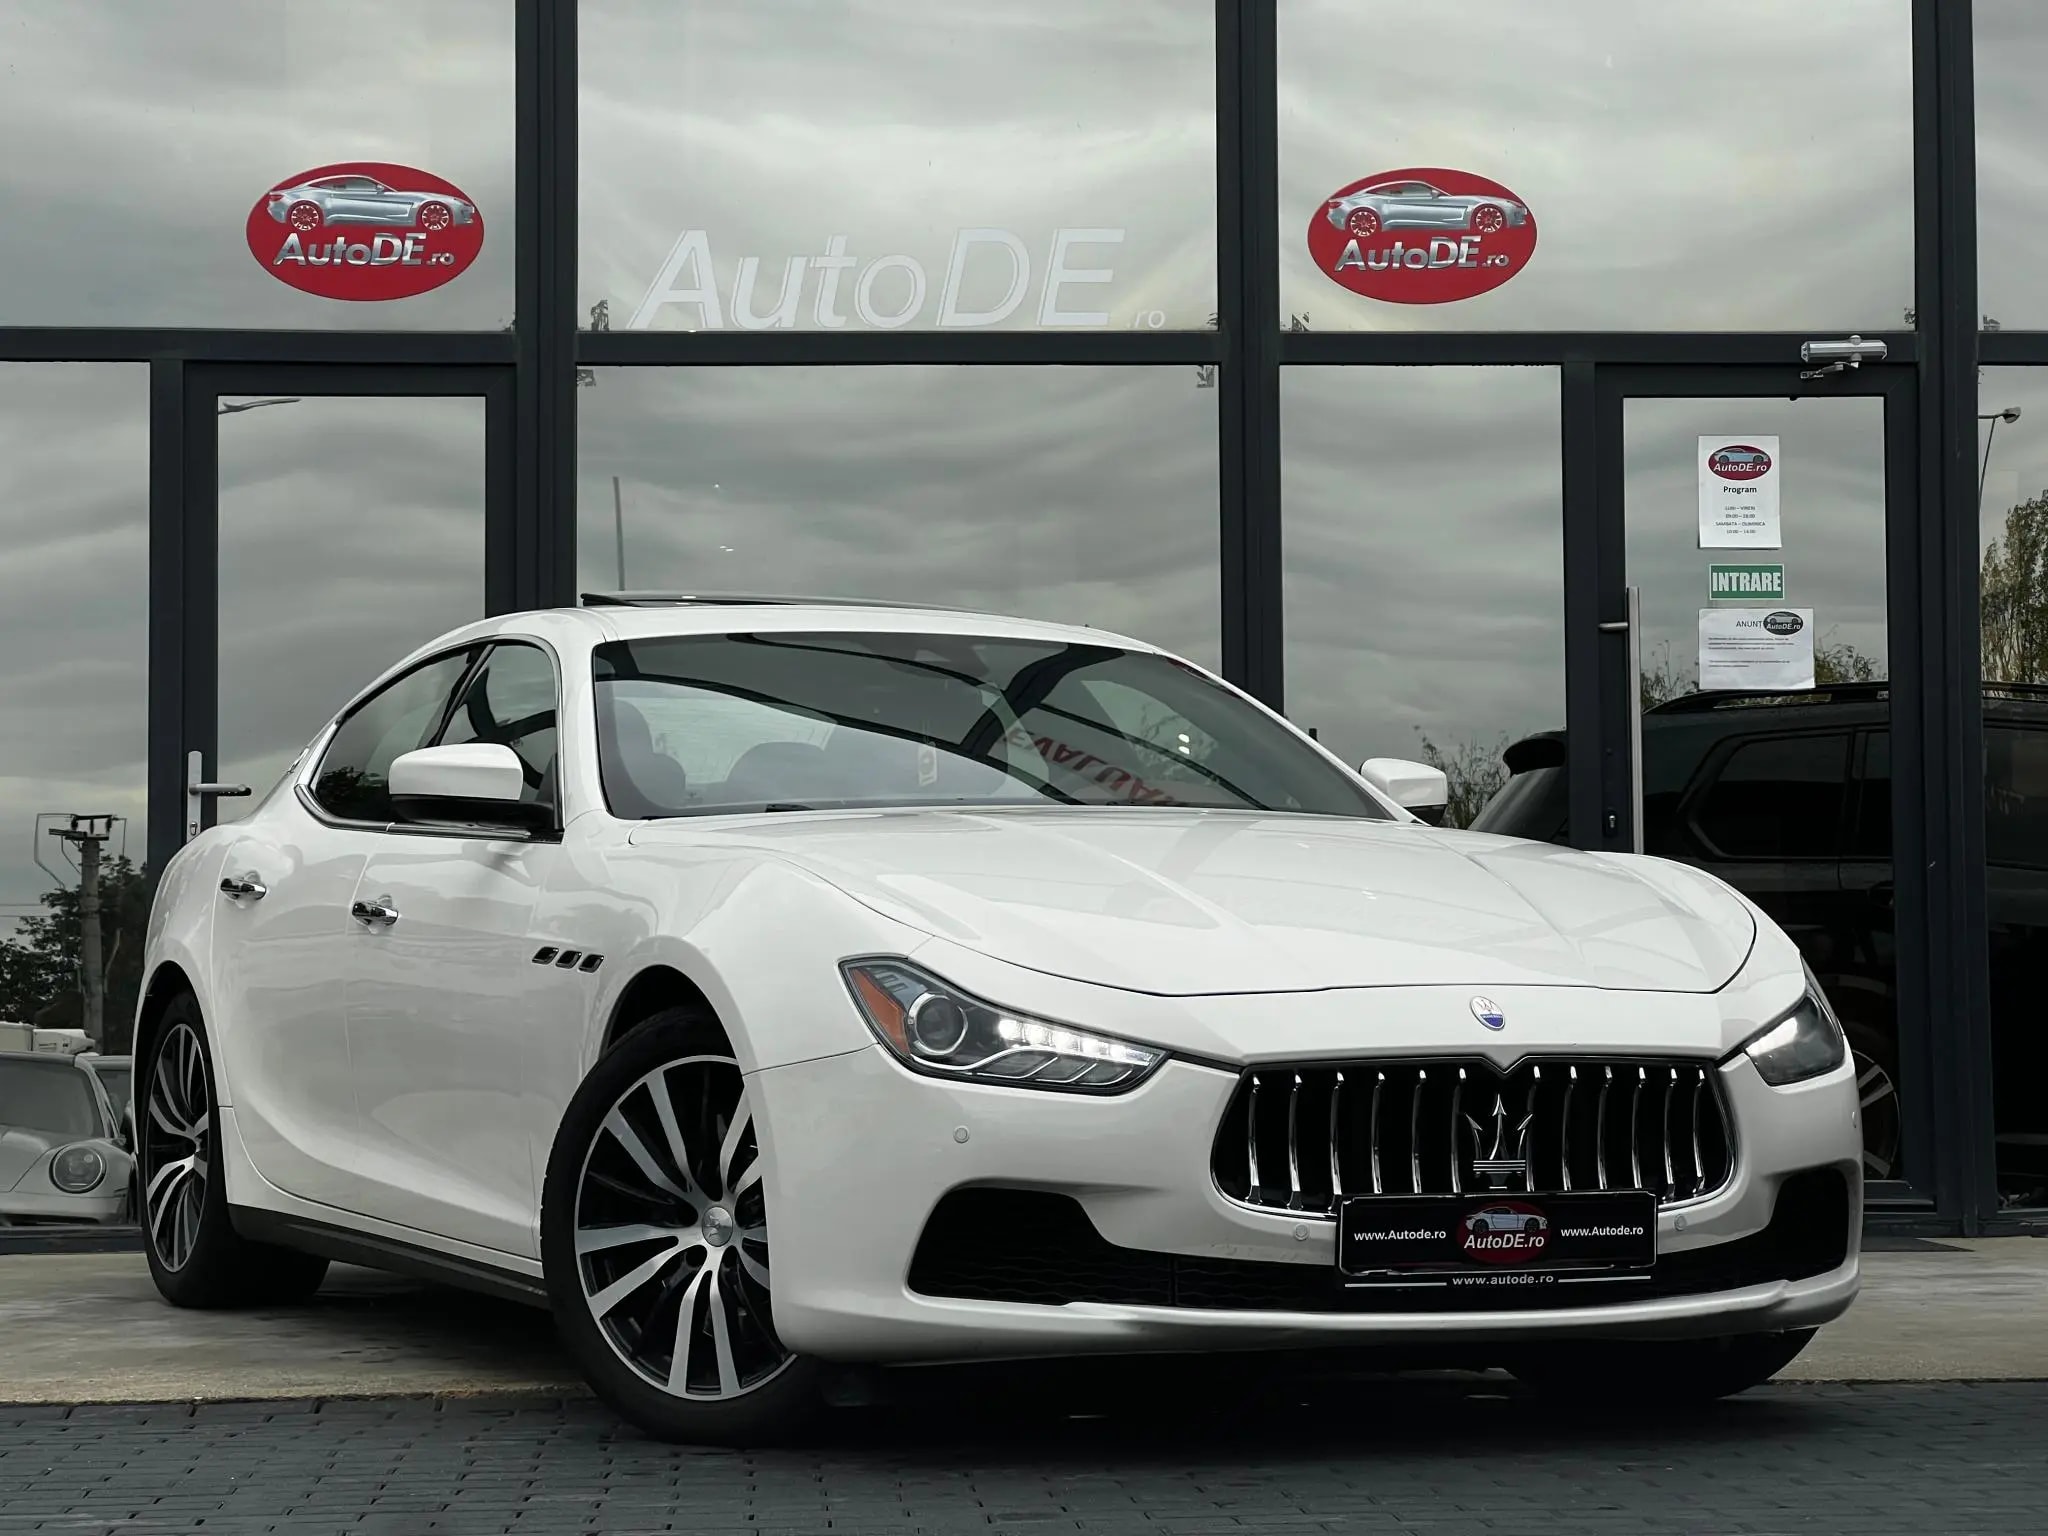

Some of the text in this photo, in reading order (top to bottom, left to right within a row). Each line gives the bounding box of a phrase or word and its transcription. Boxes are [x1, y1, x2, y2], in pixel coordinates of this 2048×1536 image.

[1713, 463, 1767, 472] AutoDE.ro
[1723, 485, 1757, 495] Program
[1712, 572, 1782, 592] INTRARE
[1354, 1229, 1447, 1241] www.Autode.ro
[1560, 1225, 1644, 1237] www.Autode.ro
[1464, 1233, 1545, 1249] AutoDE.ro
[1452, 1273, 1554, 1286] www.autode.ro
